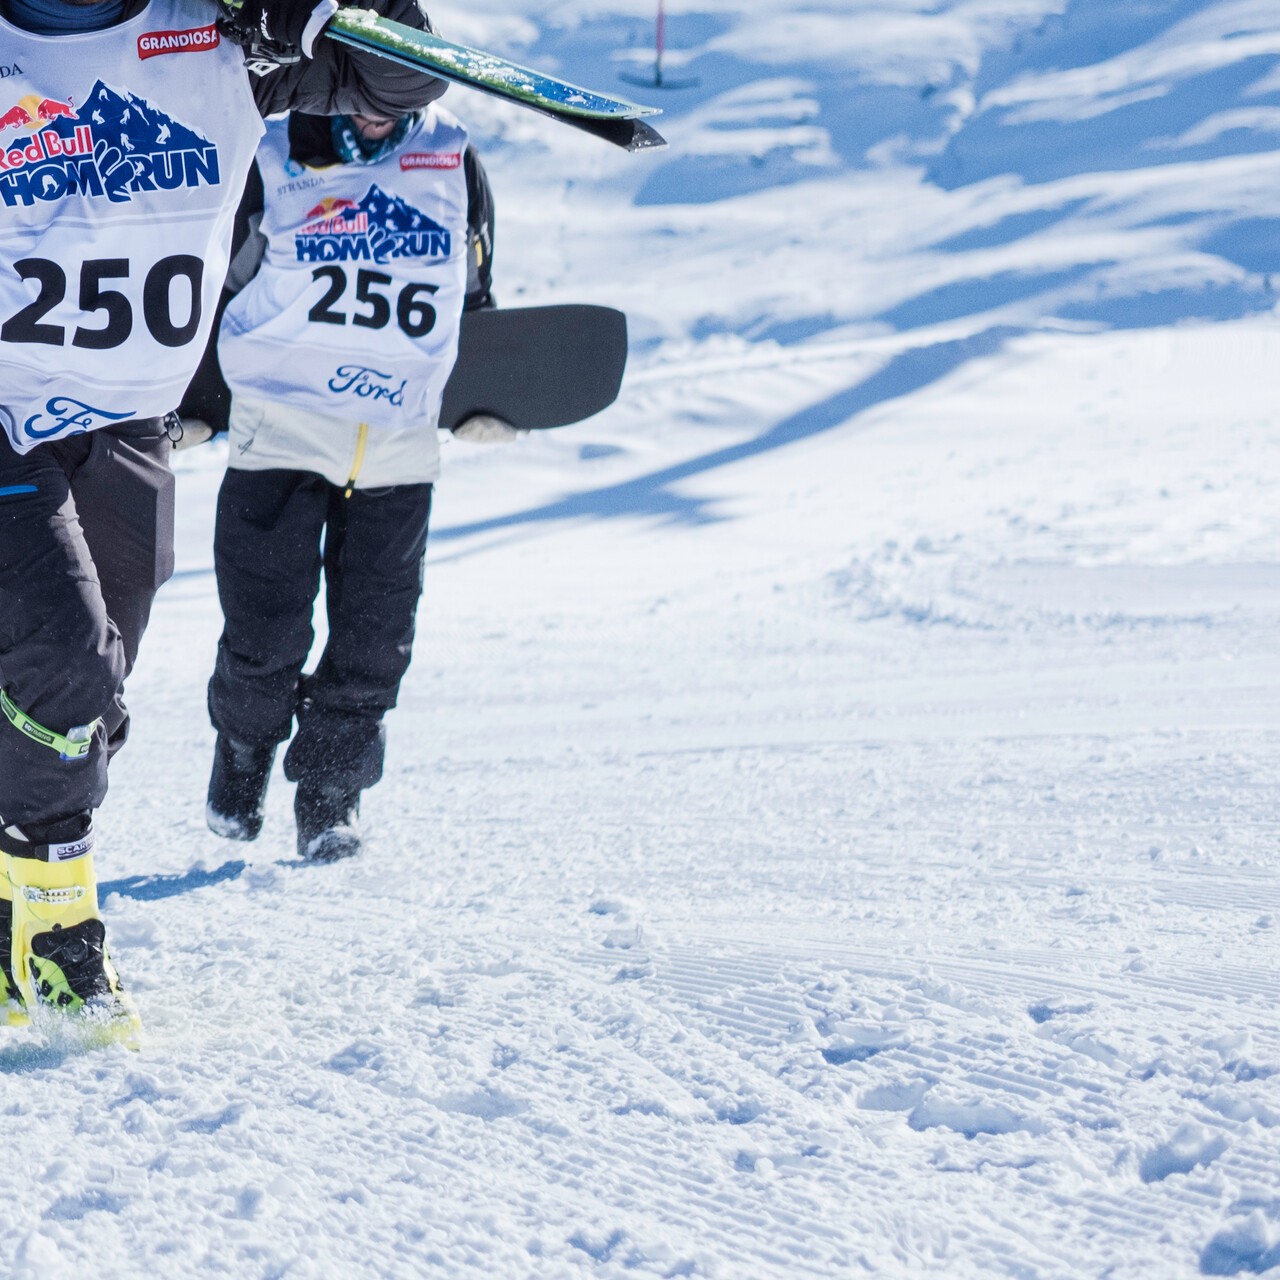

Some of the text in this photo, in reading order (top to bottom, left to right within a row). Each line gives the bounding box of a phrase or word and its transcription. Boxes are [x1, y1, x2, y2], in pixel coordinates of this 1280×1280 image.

[140, 28, 217, 51] GRANDIOSA
[44, 125, 94, 158] Bull
[401, 154, 459, 167] GRANDIOSA
[277, 176, 326, 196] STRANDA
[331, 212, 369, 235] Bull
[0, 254, 204, 350] 250
[308, 265, 440, 338] 256
[328, 365, 407, 407] Ford
[58, 838, 93, 856] SCAR
